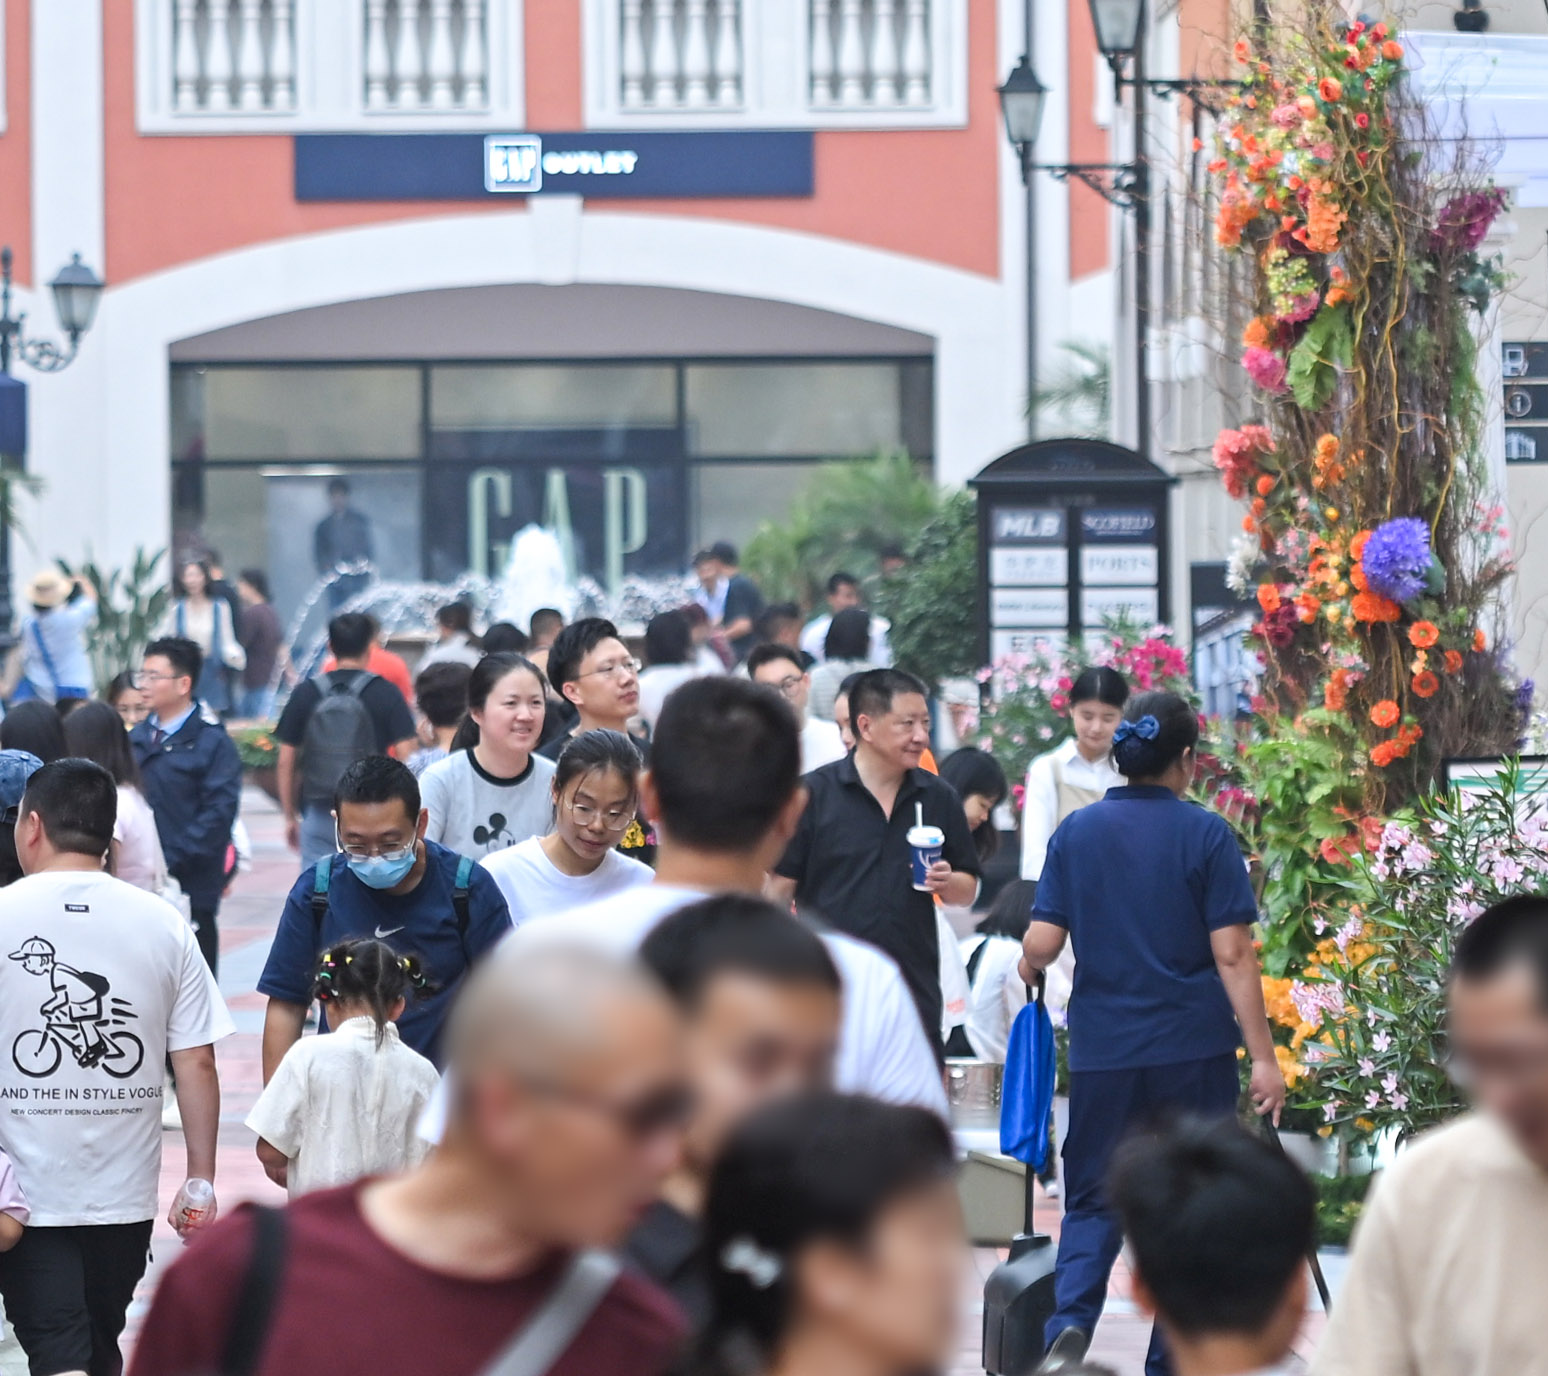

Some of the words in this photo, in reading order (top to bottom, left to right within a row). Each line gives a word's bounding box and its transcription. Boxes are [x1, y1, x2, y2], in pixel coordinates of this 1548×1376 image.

[999, 514, 1060, 538] MLB
[32, 1088, 61, 1099] THE
[65, 1089, 79, 1099] IN
[82, 1088, 126, 1099] STYLE
[11, 1108, 26, 1116] NEW
[27, 1108, 62, 1116] CONCERT
[65, 1108, 91, 1116] DESIGN
[93, 1108, 119, 1116] CLASSIC
